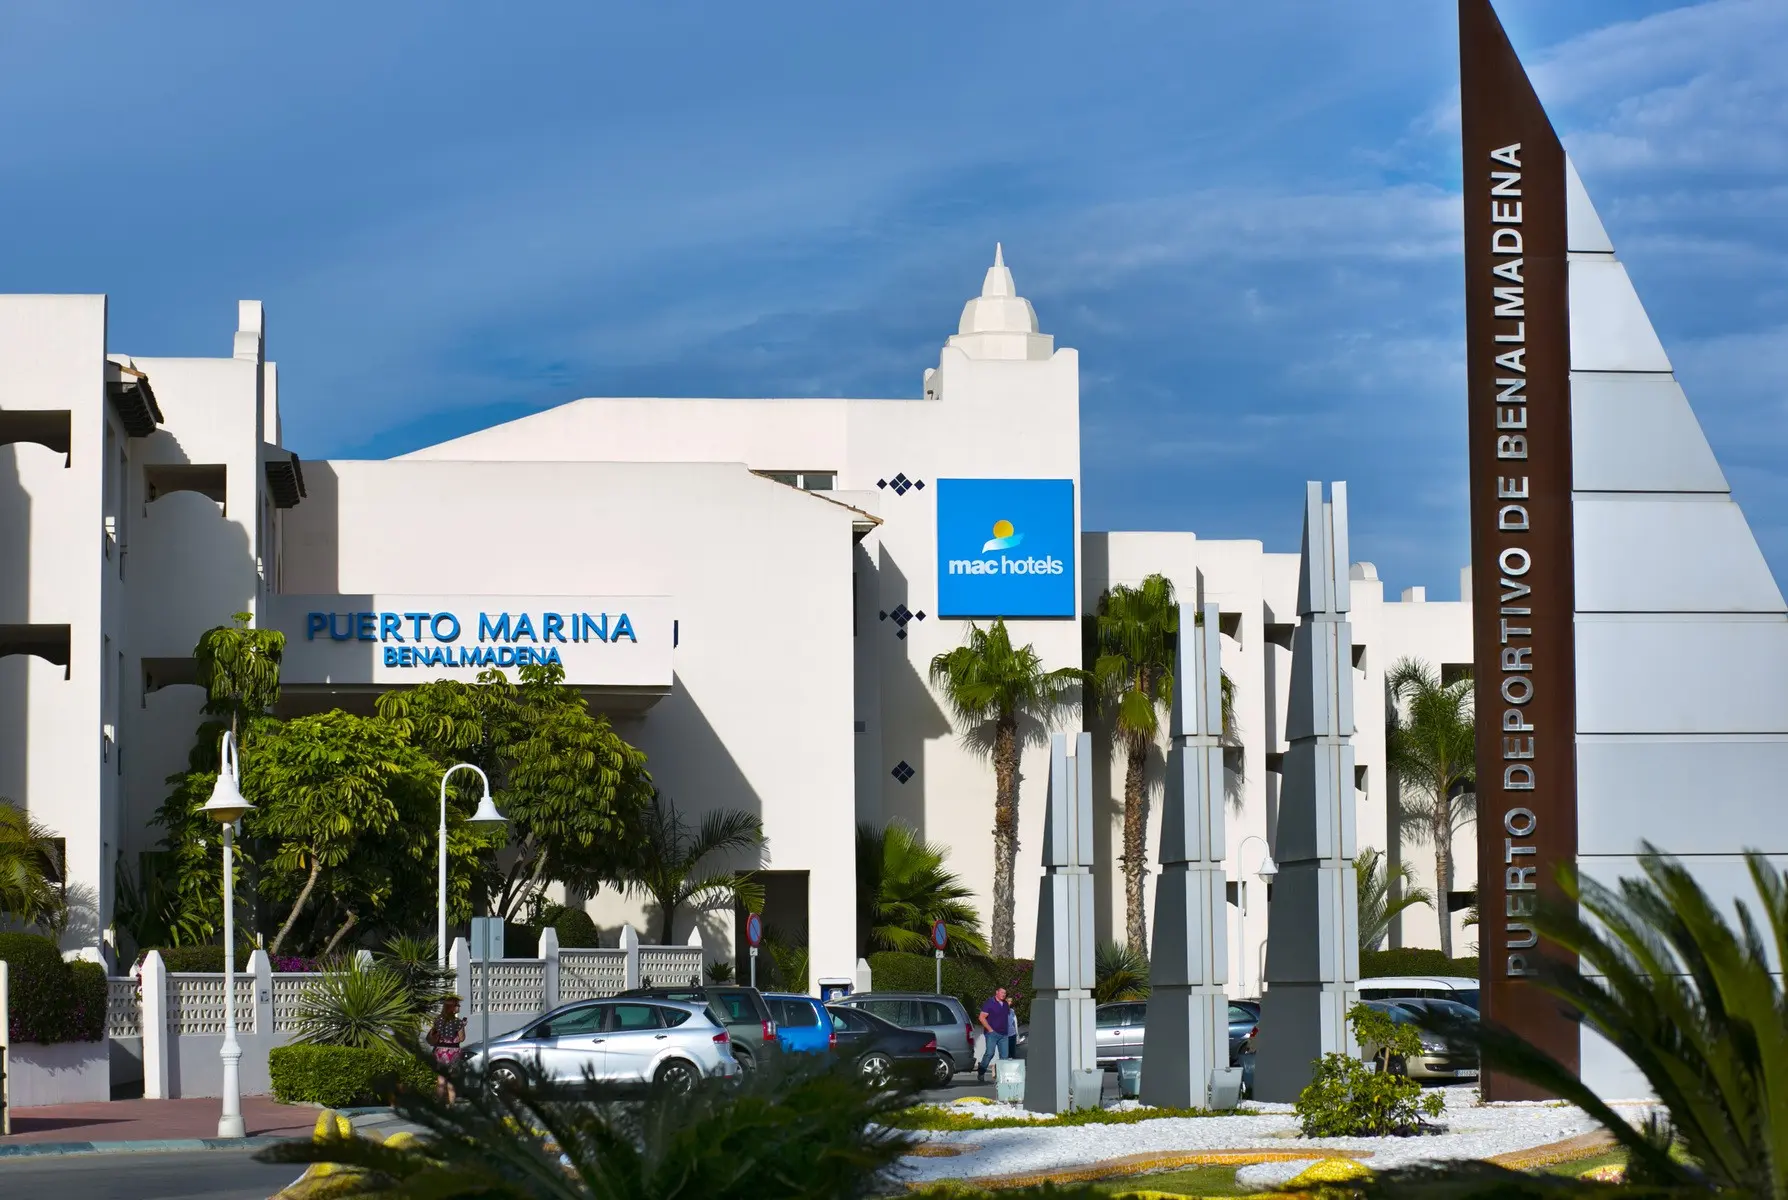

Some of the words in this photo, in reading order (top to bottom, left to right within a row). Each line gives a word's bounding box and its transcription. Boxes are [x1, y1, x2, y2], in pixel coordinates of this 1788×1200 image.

[1490, 142, 1528, 460] BENALMADENA
[1498, 476, 1530, 531] DE
[948, 559, 998, 575] mac
[1001, 555, 1063, 575] hotels
[307, 611, 462, 643] PUERTO
[478, 611, 638, 643] MARINA
[383, 645, 562, 668] BENALMADENA
[1498, 547, 1536, 790] DEPORTIVO
[1504, 807, 1538, 976] PUERTO
